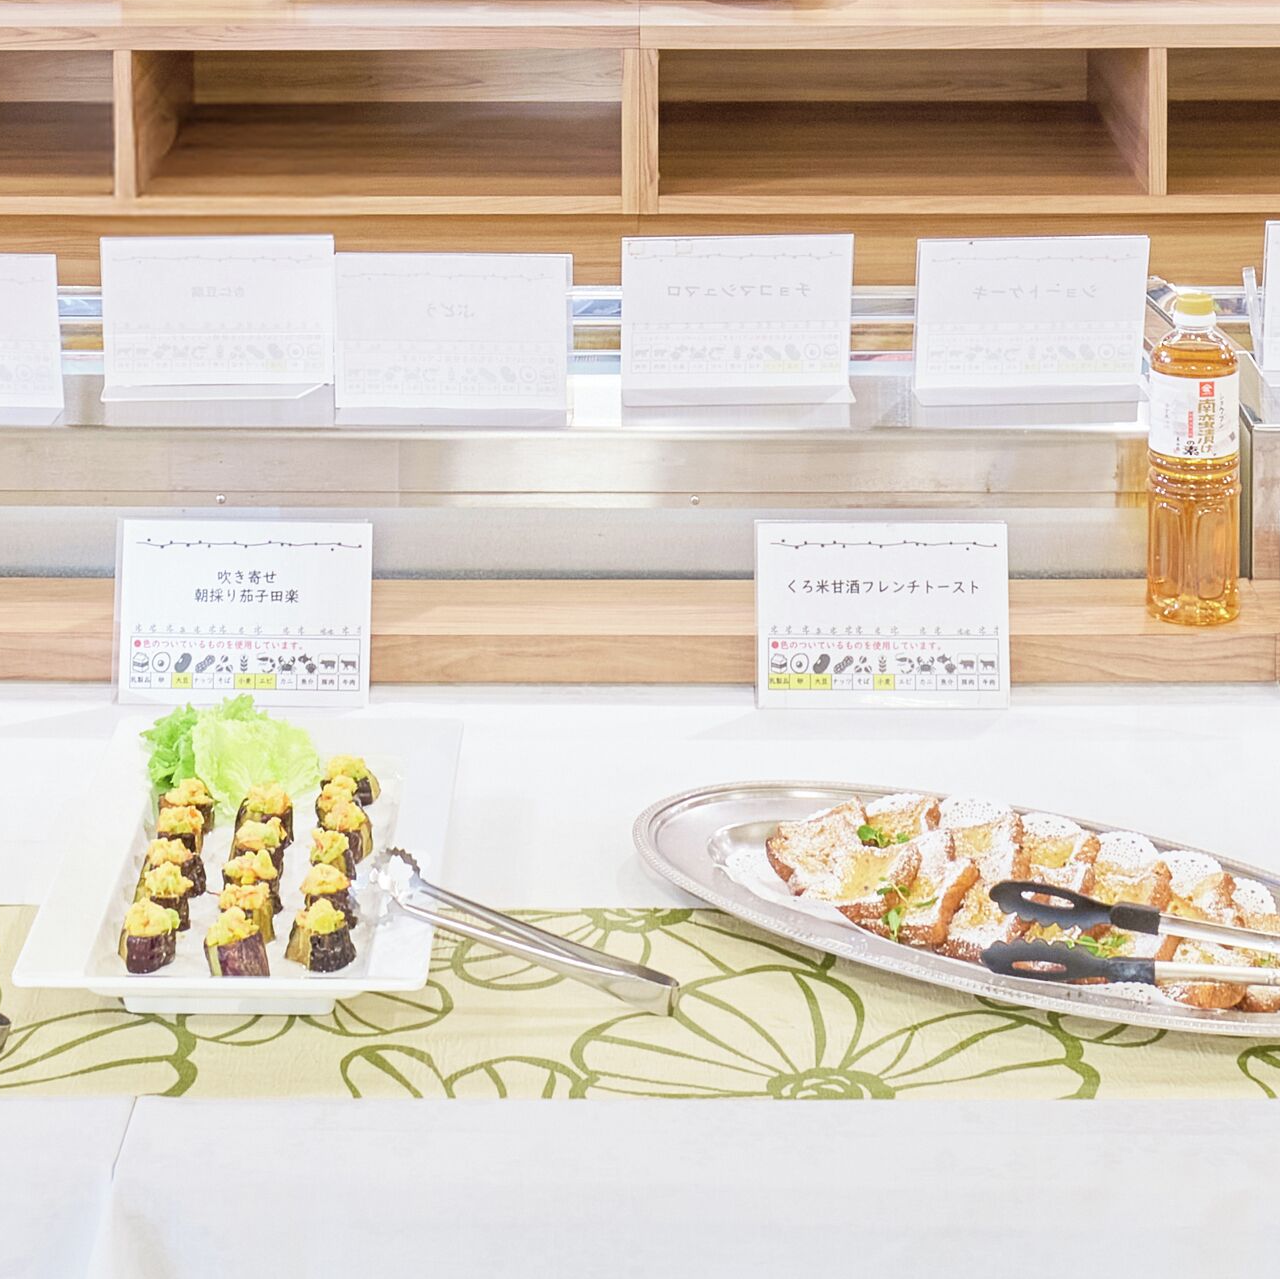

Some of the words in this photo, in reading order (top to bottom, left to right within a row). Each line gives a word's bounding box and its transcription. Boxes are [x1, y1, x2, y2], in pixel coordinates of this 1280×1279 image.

[217, 569, 277, 586] 吹き寄せ
[787, 579, 979, 595] くろ米甘酒フレンチトースト
[194, 588, 299, 604] 朝採り茄子田楽
